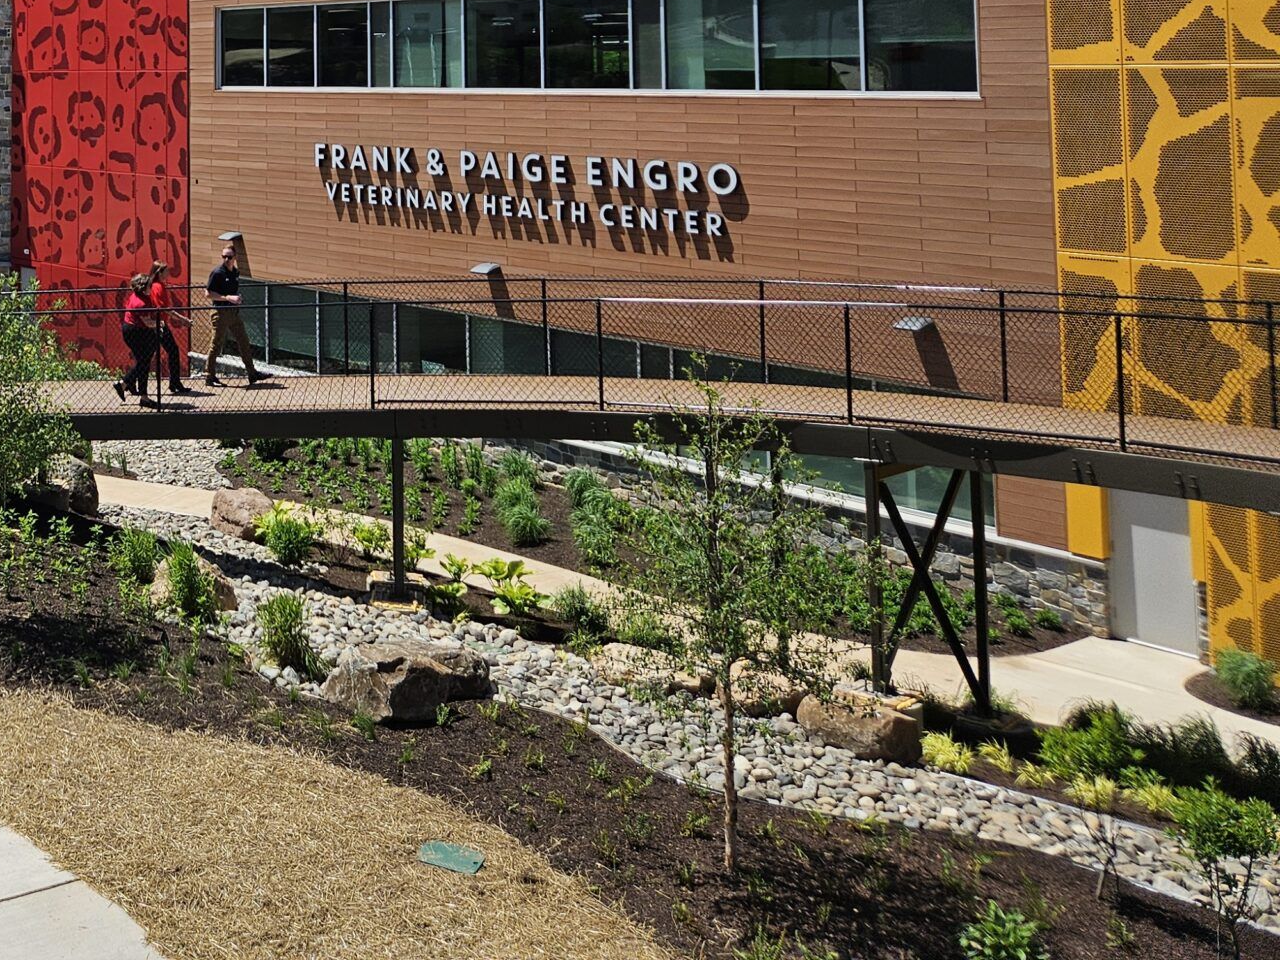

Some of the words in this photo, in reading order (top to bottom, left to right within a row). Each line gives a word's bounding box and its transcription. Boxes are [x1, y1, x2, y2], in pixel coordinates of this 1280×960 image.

[314, 143, 413, 174] FRANK
[426, 148, 446, 176] &
[460, 150, 568, 184] PAIGE
[586, 156, 738, 195] ENGRO
[325, 182, 470, 213] VETERINARY
[483, 194, 586, 224] HEALTH
[599, 204, 723, 236] CENTER
